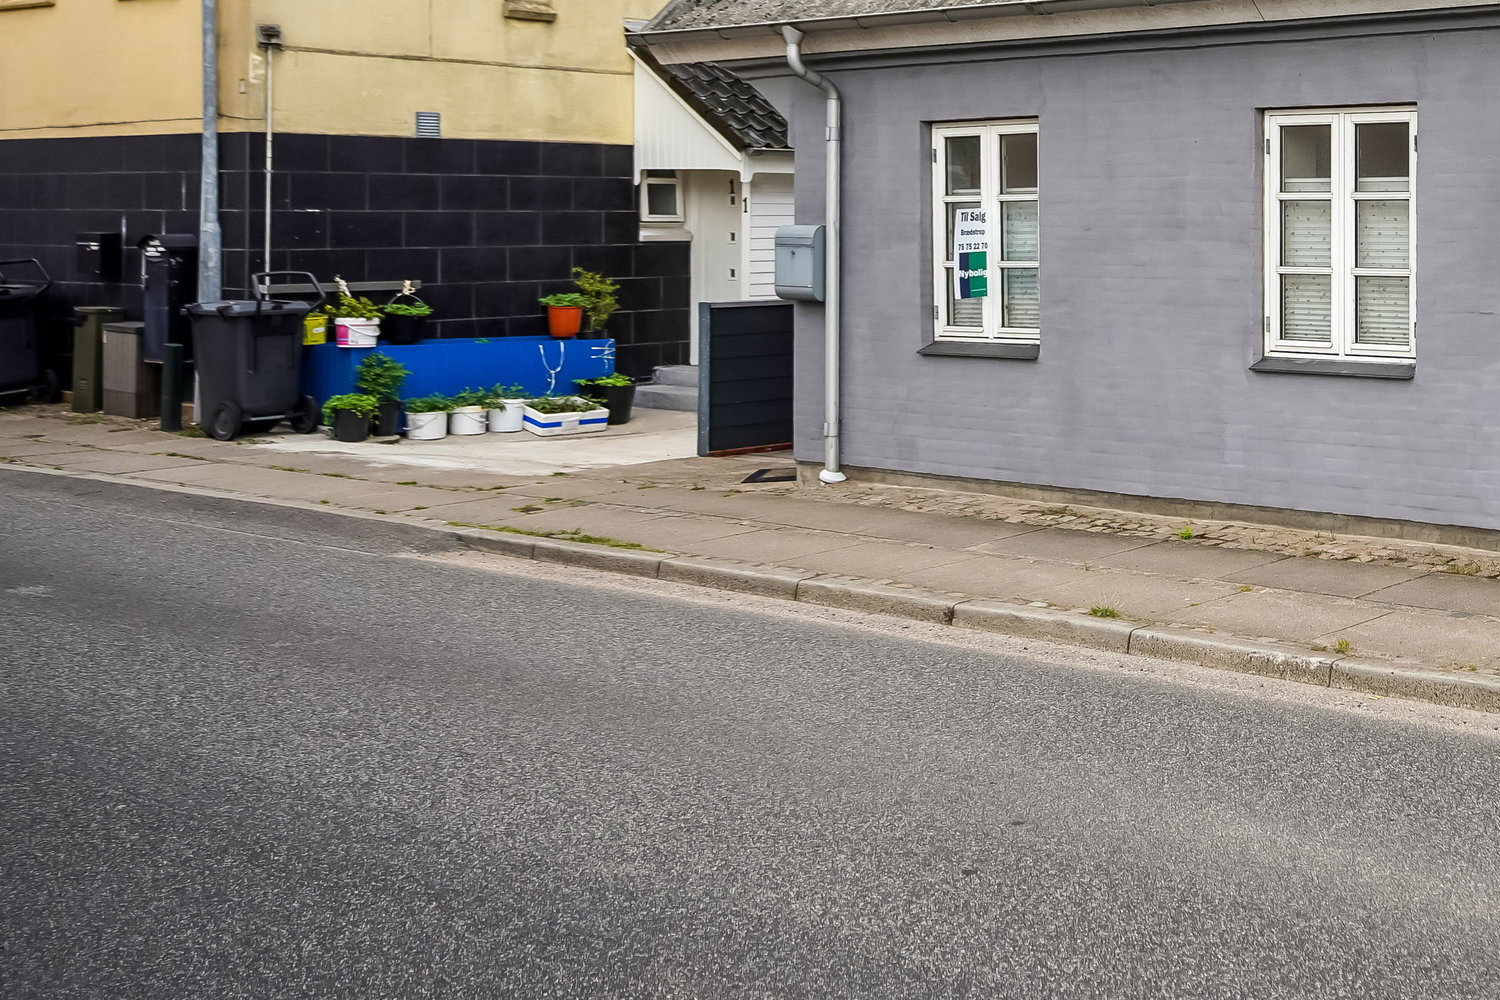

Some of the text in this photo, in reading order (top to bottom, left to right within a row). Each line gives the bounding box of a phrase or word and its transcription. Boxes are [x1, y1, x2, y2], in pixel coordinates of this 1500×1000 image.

[742, 197, 748, 213] 1
[961, 211, 986, 223] Til Salg
[959, 269, 987, 279] Nybolig
